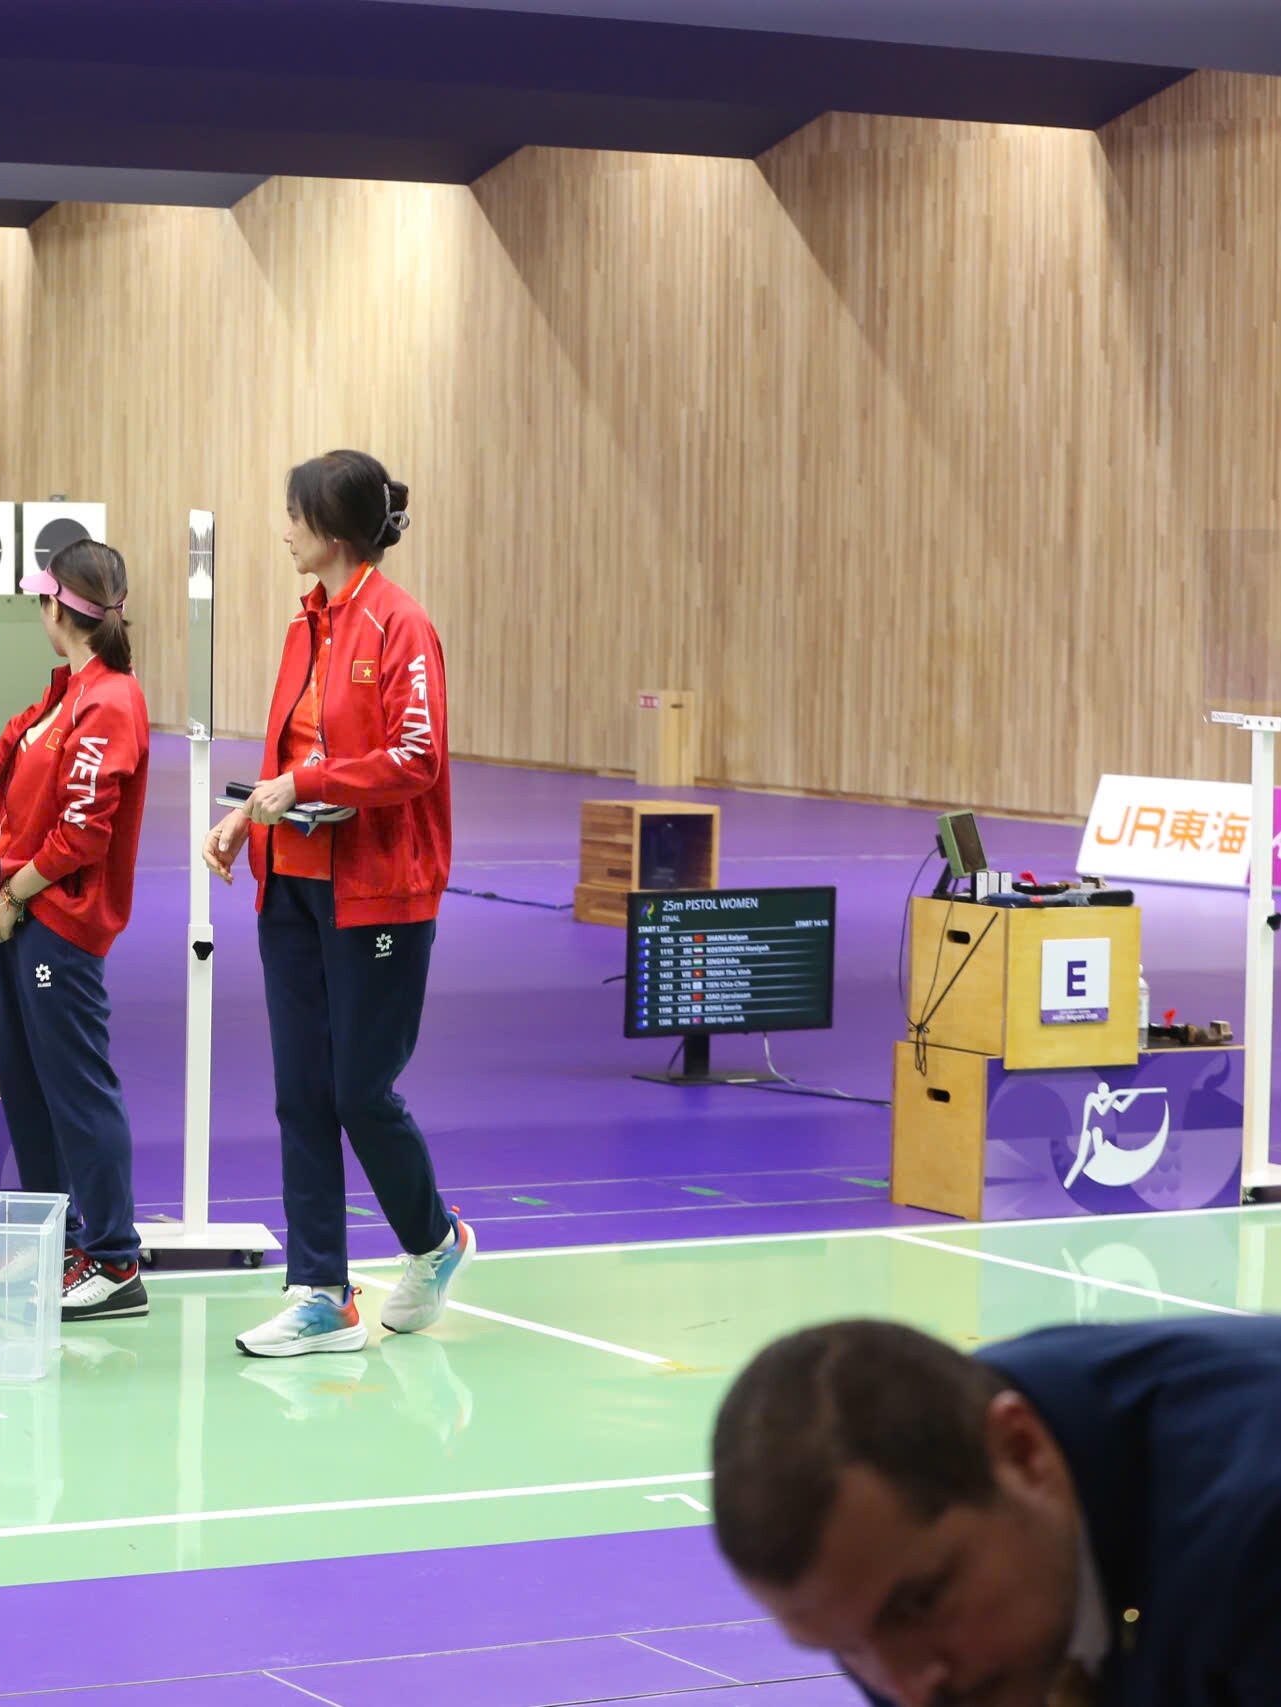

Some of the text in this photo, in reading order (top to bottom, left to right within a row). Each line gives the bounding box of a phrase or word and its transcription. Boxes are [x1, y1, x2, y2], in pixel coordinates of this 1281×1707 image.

[662, 897, 759, 912] 25m PISTOL WOMEN
[661, 915, 681, 923] FINAL
[638, 925, 670, 934] START LIST
[1066, 960, 1087, 997] E
[642, 1493, 711, 1512] 7
